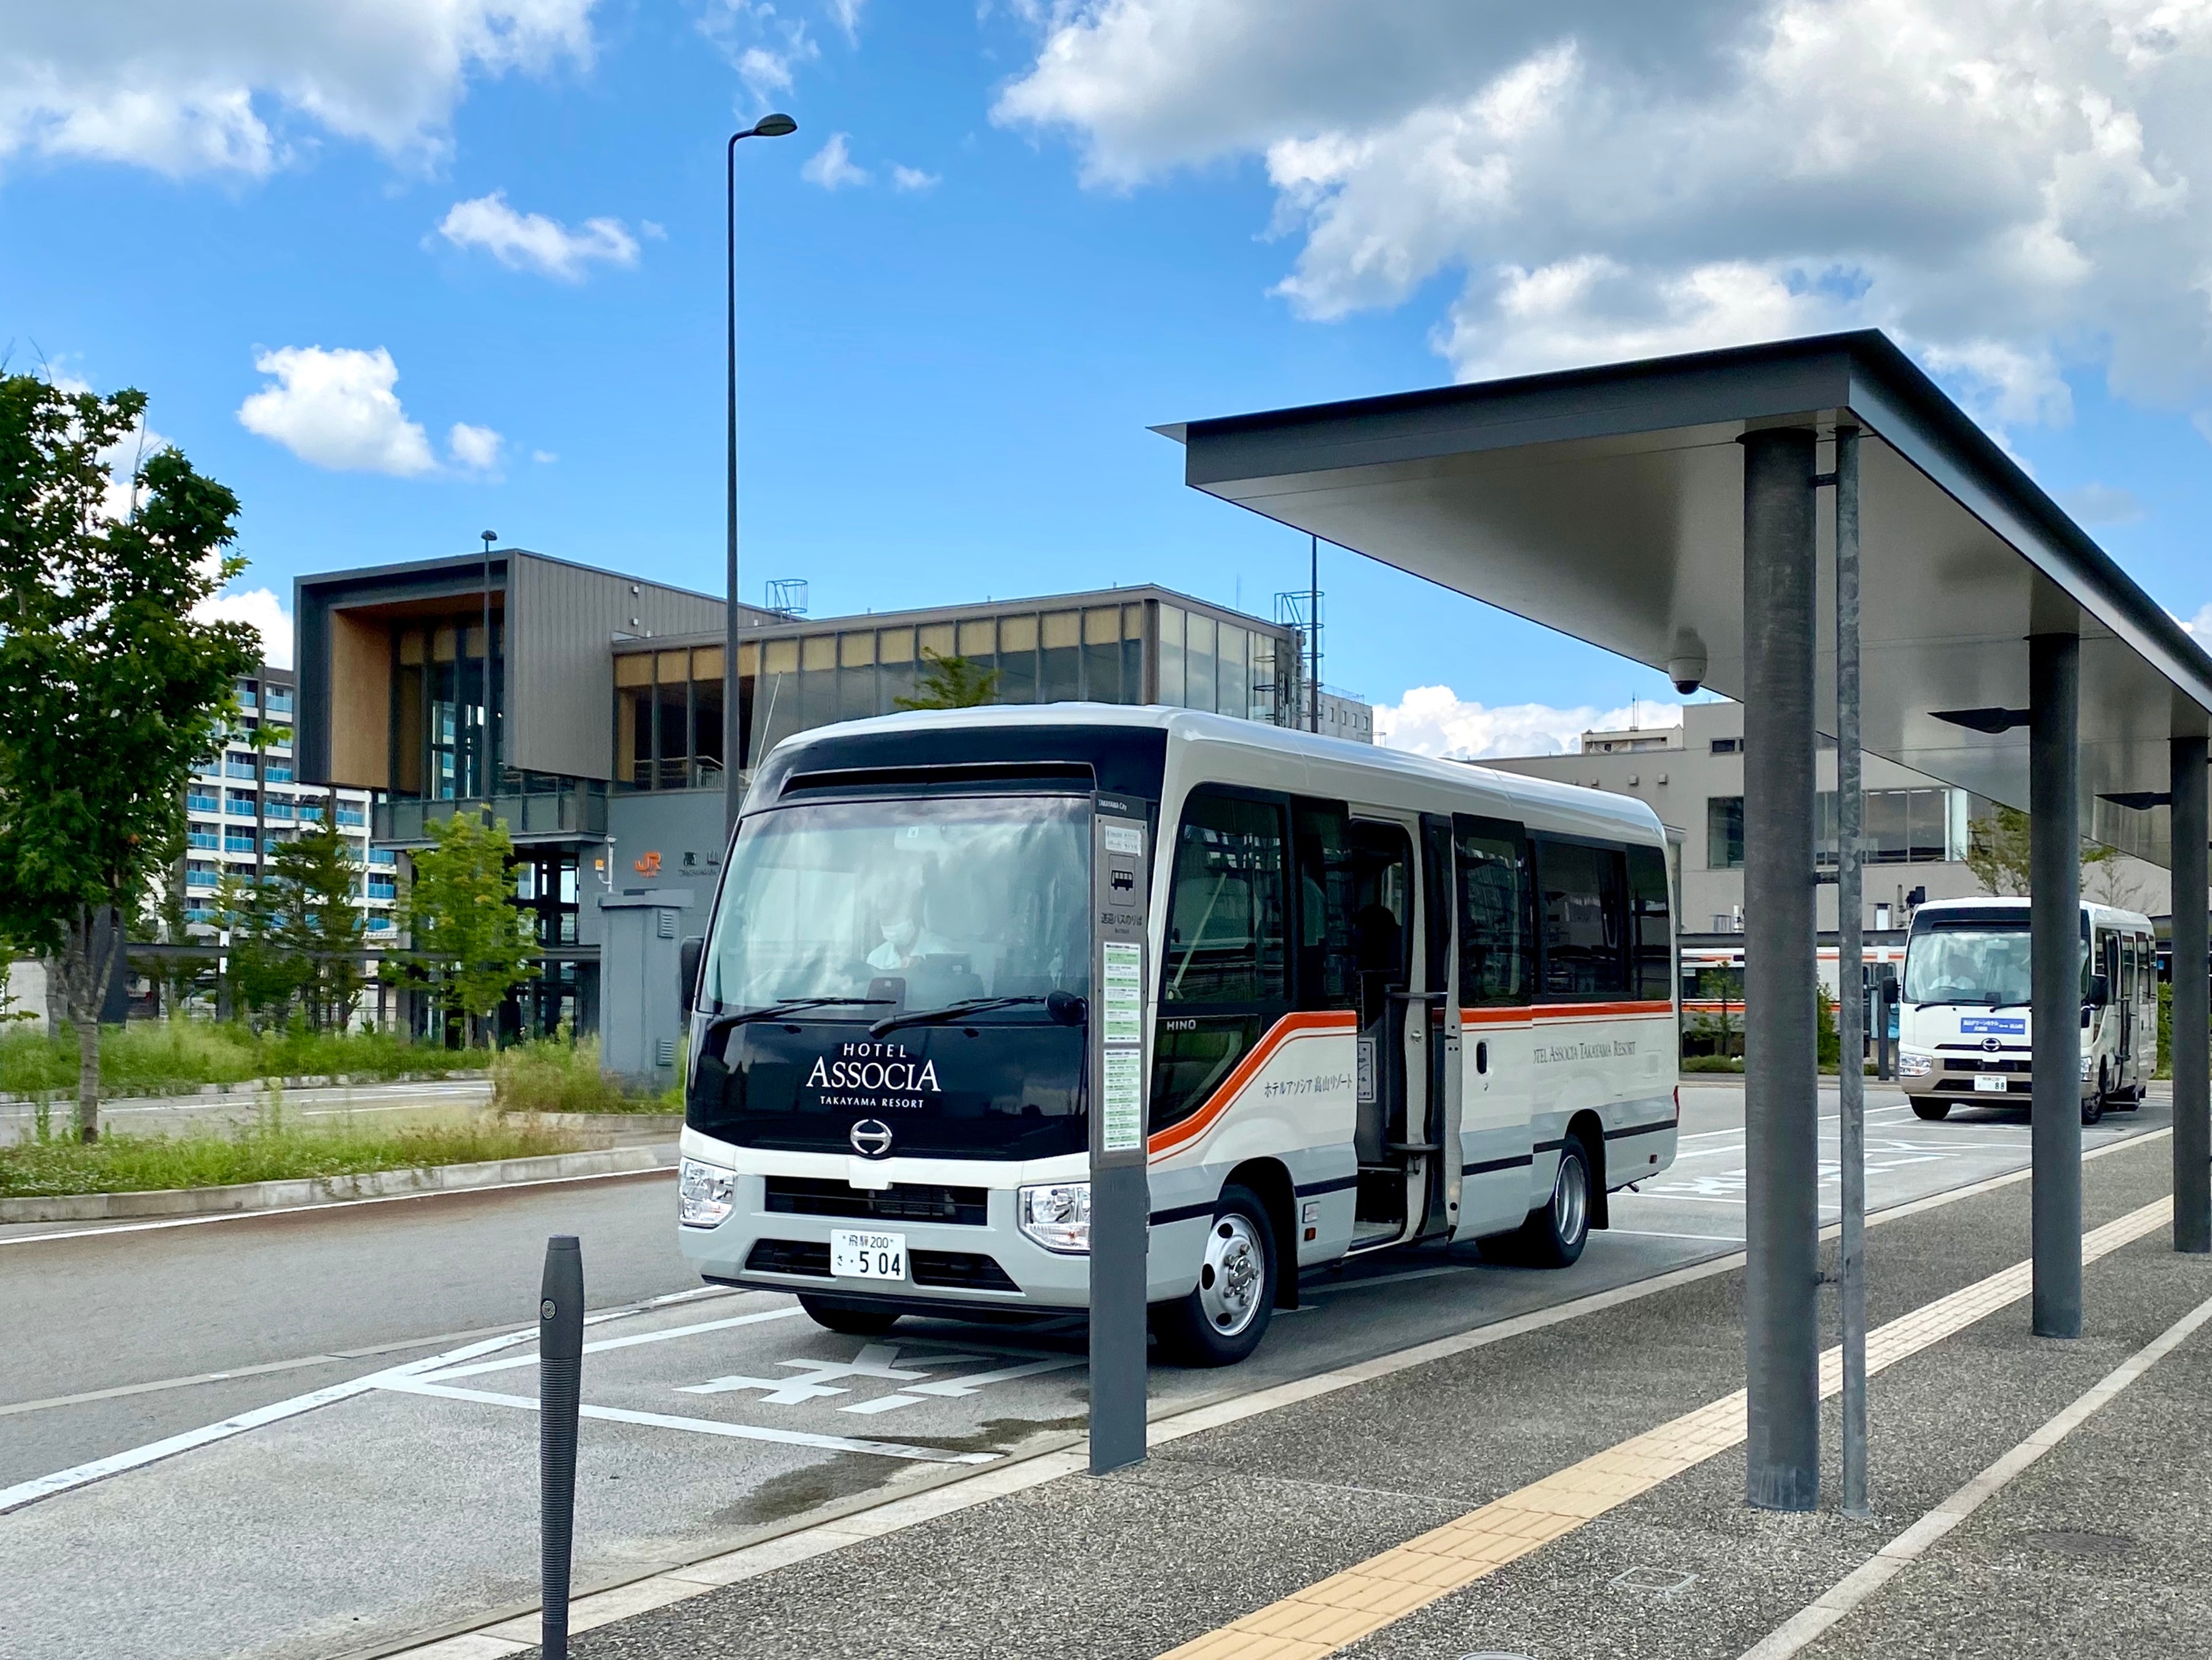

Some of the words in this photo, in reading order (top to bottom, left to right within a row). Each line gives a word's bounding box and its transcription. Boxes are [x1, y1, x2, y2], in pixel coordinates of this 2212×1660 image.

[634, 851, 661, 871] JR
[1101, 913, 1142, 926] 送迎バスのりば
[1167, 1019, 1196, 1031] HINO
[843, 1043, 906, 1058] HOTEL
[1549, 1046, 1578, 1063] ASSOCIA
[1579, 1043, 1612, 1059] TAKAYAMA
[1614, 1040, 1636, 1056] RESORT
[806, 1056, 942, 1092] ASSOCIA
[820, 1096, 876, 1106] TAKAYAMA
[882, 1098, 924, 1108] RESORT
[837, 1254, 843, 1267] さ
